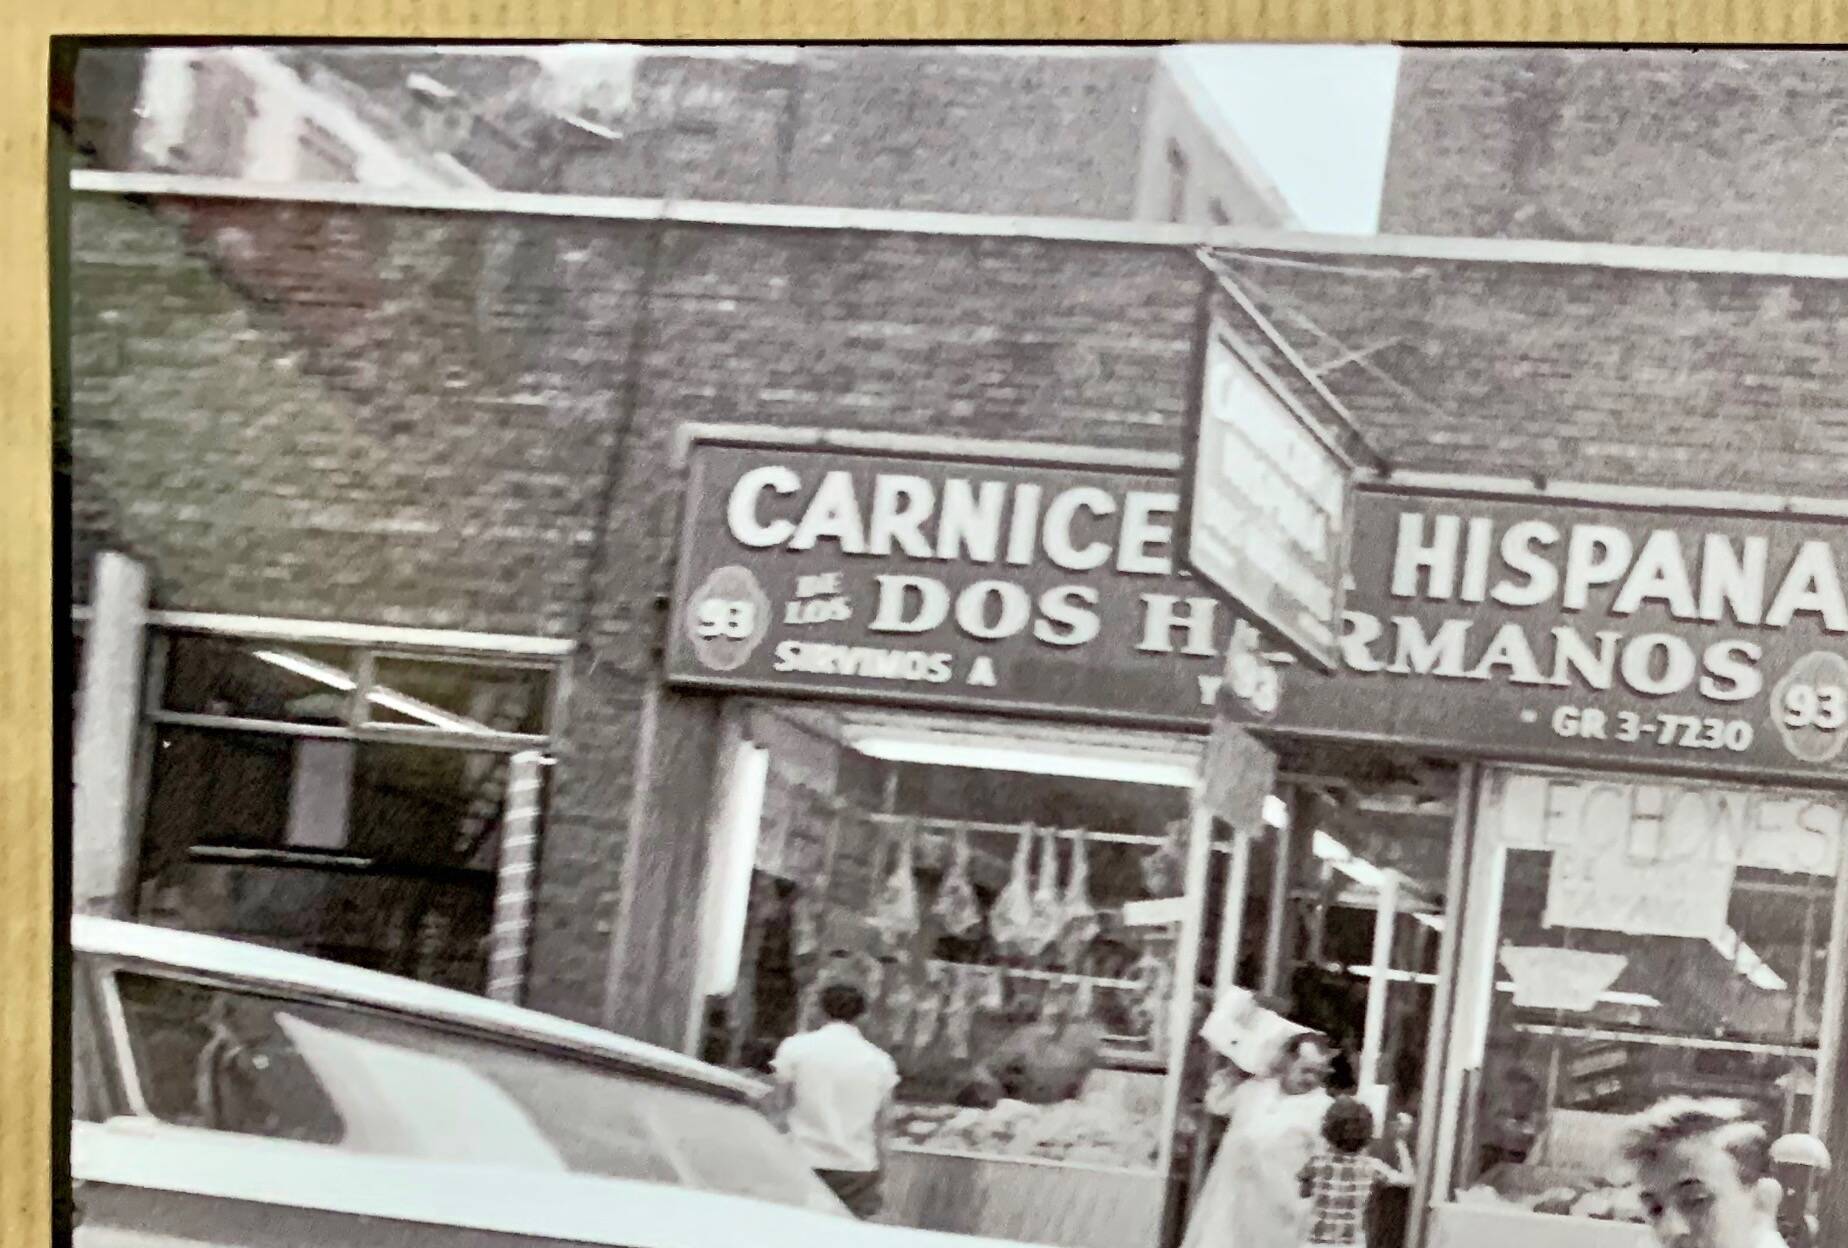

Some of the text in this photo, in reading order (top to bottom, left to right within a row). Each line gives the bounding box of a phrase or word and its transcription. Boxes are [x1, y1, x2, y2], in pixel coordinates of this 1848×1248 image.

[783, 596, 853, 625] LOS
[869, 573, 1763, 702] DOS HRMANOS
[965, 656, 999, 688] A
[1551, 706, 1754, 753] GR 3-7230
[1782, 684, 1848, 731] 93
